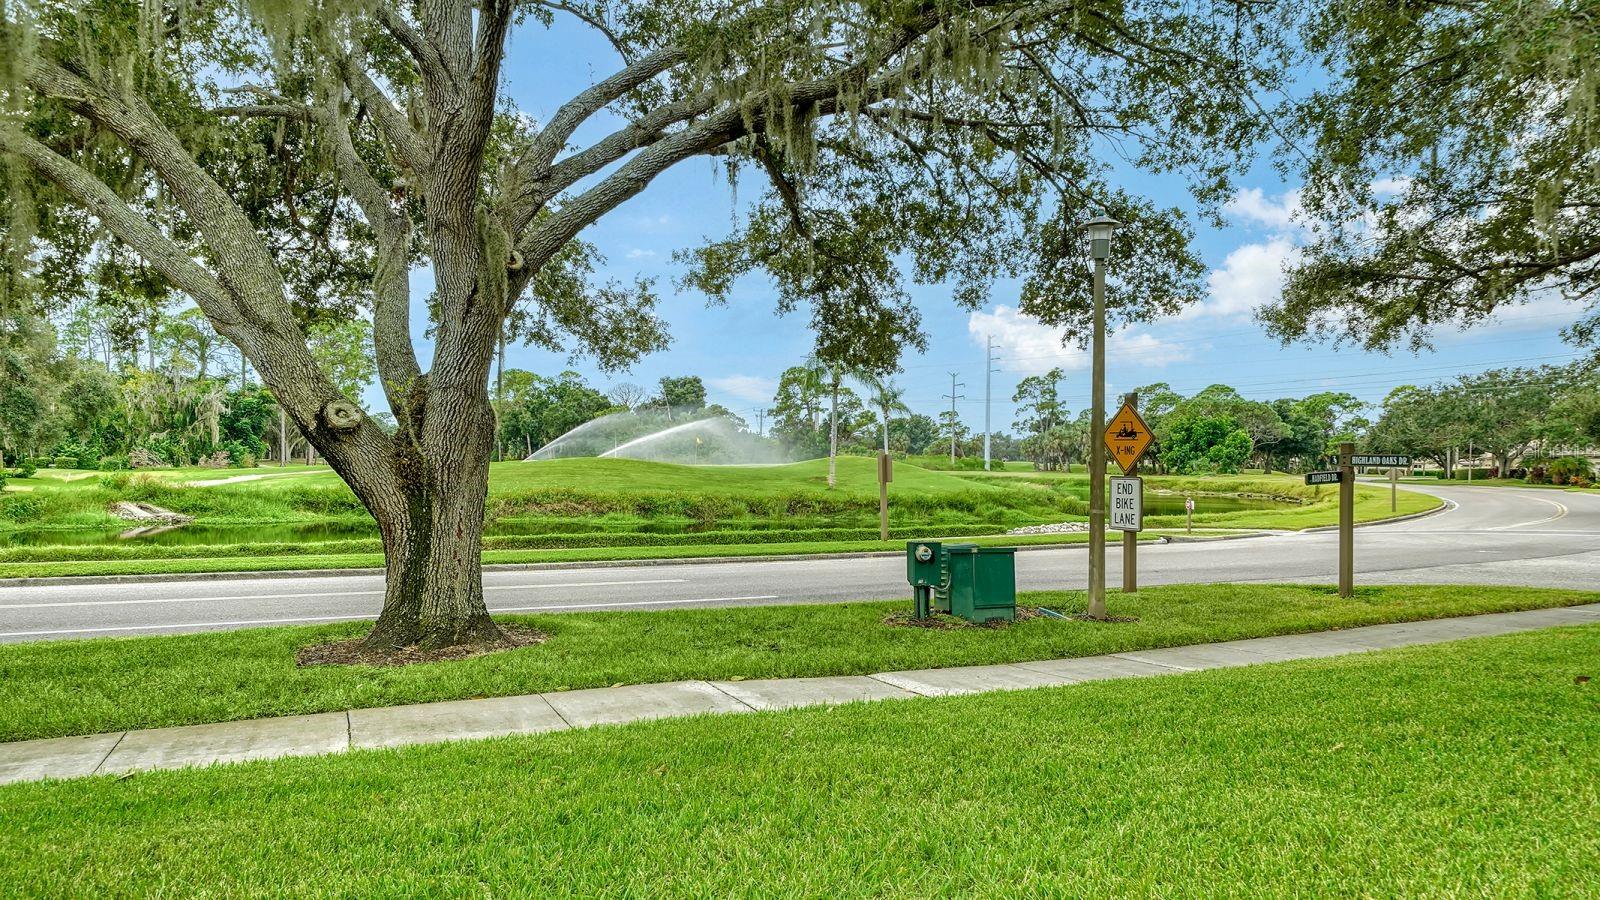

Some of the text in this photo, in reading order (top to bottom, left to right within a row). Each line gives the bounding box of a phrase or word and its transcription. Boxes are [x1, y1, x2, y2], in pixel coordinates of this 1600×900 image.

[1116, 445, 1135, 455] X-ING
[1352, 456, 1409, 464] HIGHLAND OAKS DR.
[1117, 483, 1133, 494] END
[1116, 498, 1134, 510] BIKE
[1114, 513, 1135, 525] LANE
